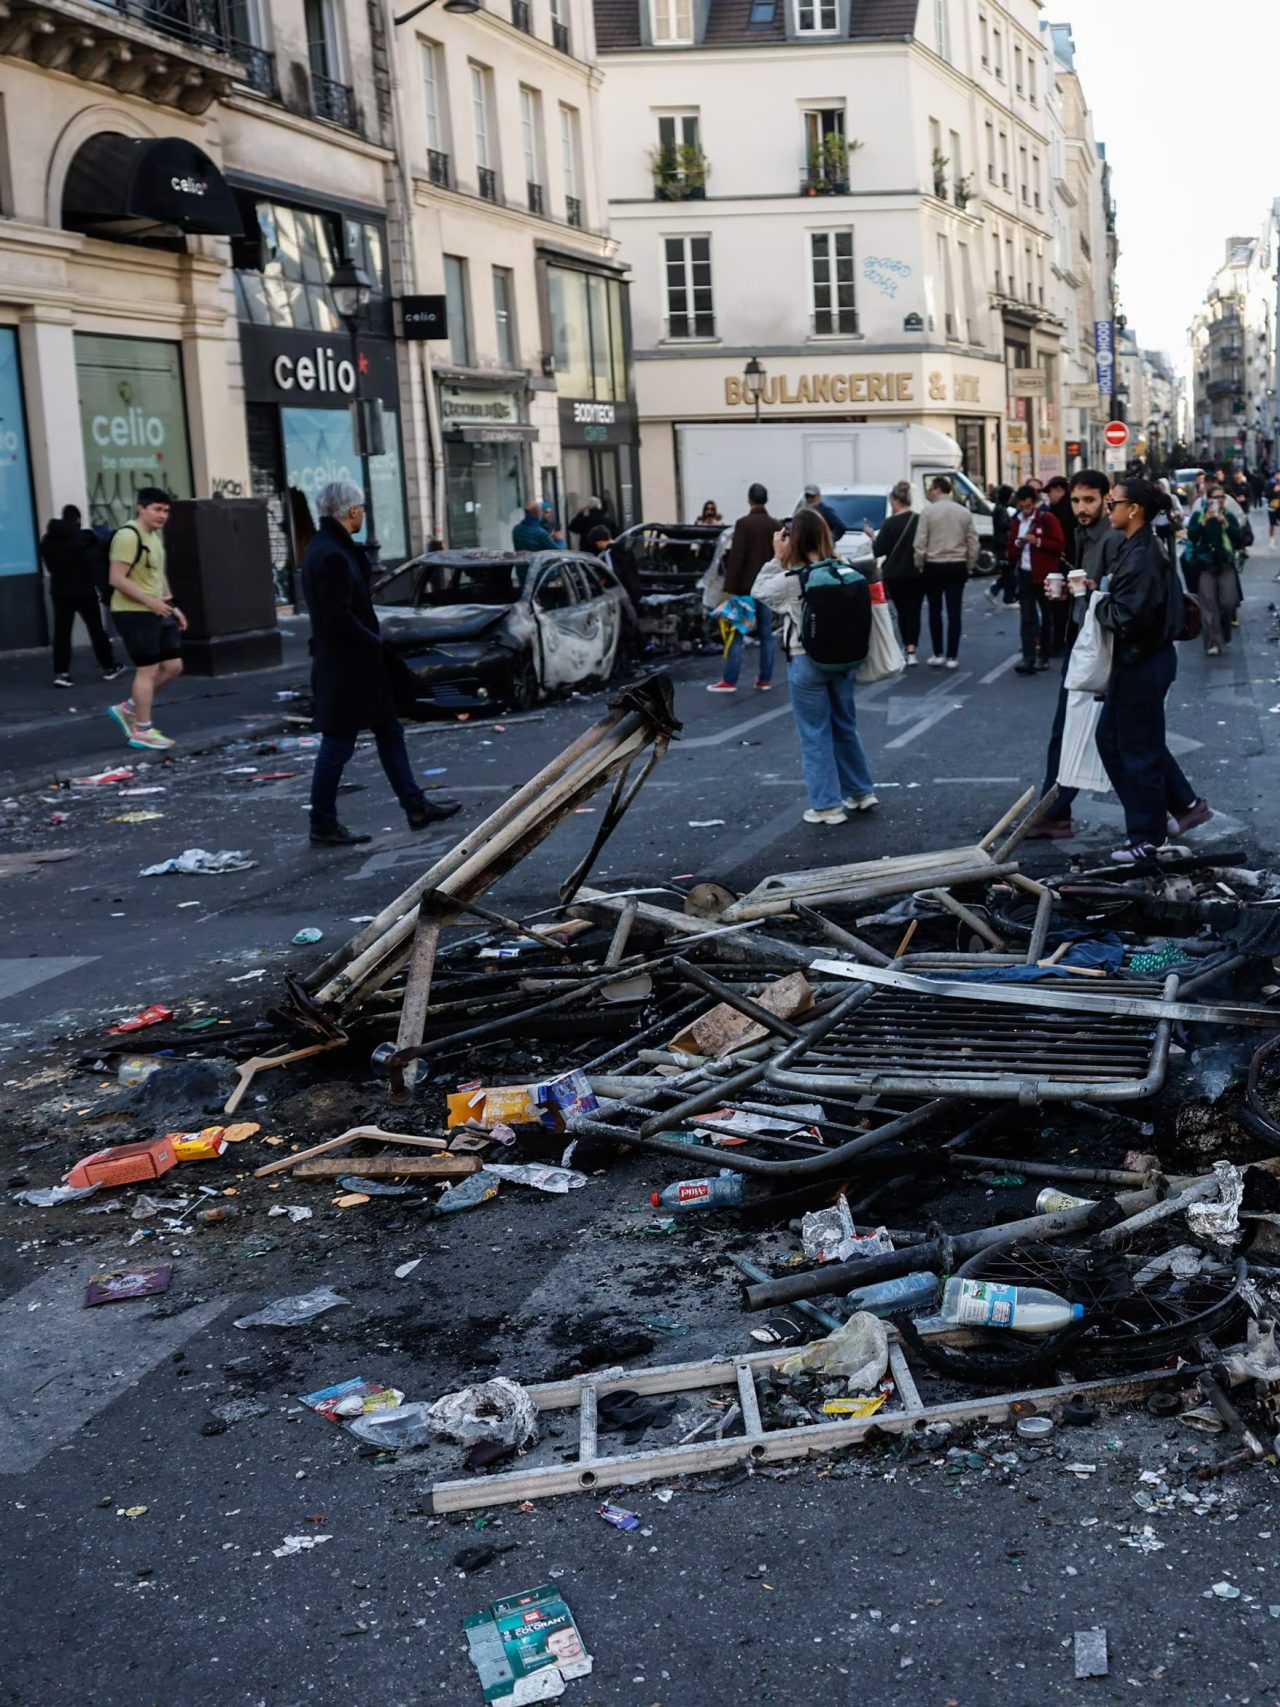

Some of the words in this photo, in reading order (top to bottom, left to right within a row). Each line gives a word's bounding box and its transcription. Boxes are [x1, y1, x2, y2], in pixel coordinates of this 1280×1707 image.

[405, 312, 437, 322] celio
[274, 347, 356, 393] celio
[929, 371, 946, 400] &
[92, 407, 165, 446] celio
[515, 1616, 566, 1636] COLORANT
